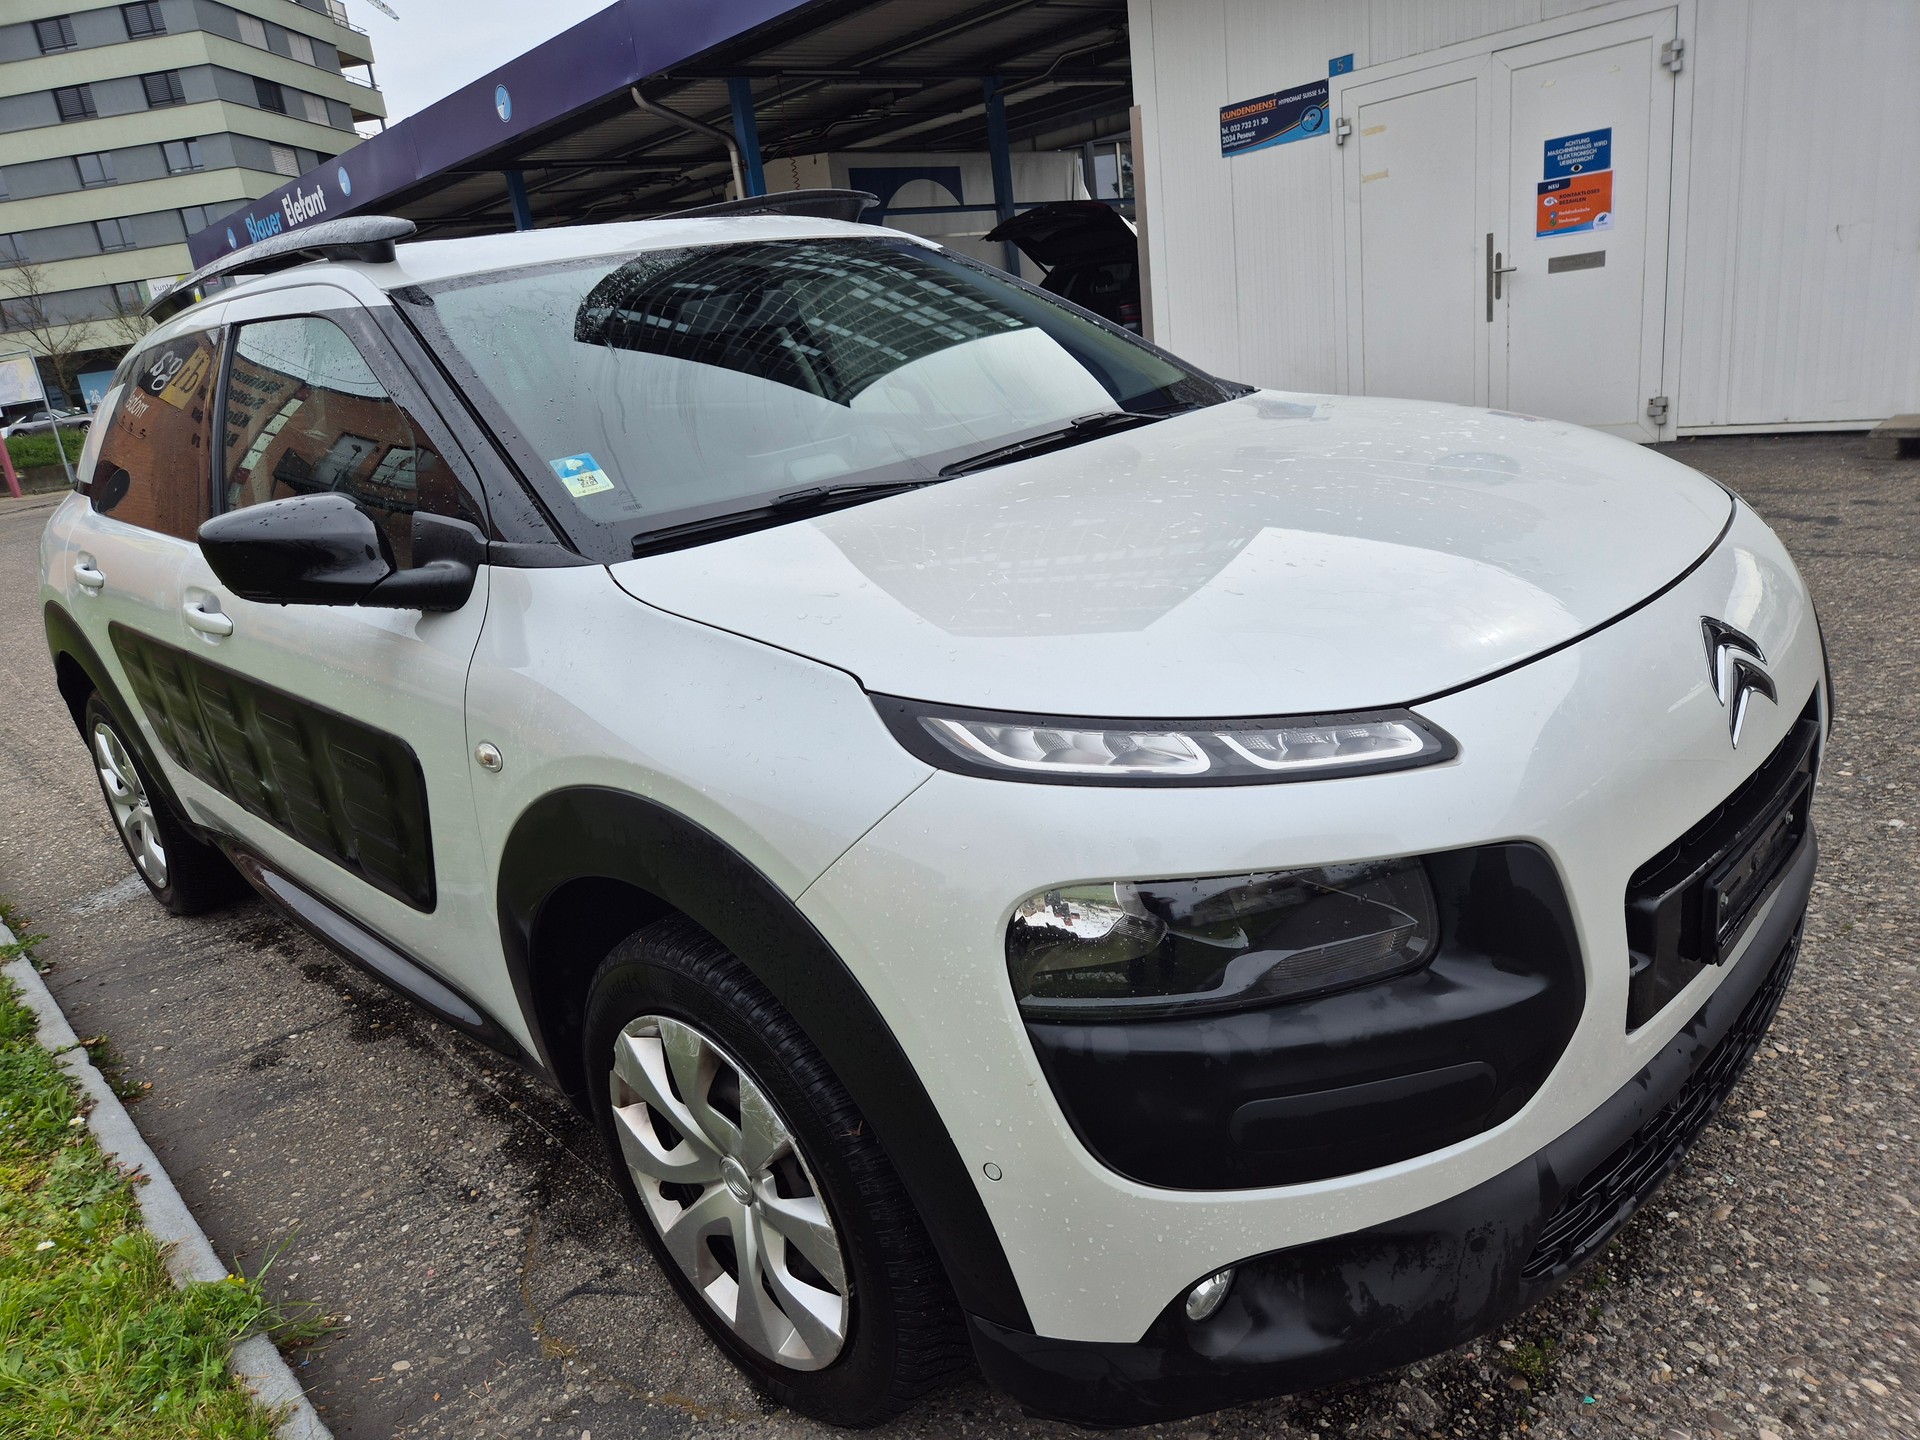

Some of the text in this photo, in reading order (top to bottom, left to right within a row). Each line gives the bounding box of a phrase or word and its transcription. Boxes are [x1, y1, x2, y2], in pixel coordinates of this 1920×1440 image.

[1337, 59, 1344, 72] 5
[1221, 99, 1277, 120] KUNDENDIENST
[1302, 90, 1317, 99] SUISSE
[1221, 117, 1268, 134] Tel. 032 732 21 30
[1222, 134, 1236, 143] 2034
[1237, 131, 1255, 140] Peseux
[1564, 137, 1591, 147] ACHTUNG
[1547, 139, 1608, 157] MASCHINENHAUS WIRD
[1557, 148, 1598, 161] ELEKTRONISCH
[1559, 154, 1595, 166] UEBERWACHT
[1559, 188, 1600, 199] KONTAKTLOSES
[1558, 197, 1587, 206] BEZAHLEN
[245, 184, 327, 244] Blauer Elefant
